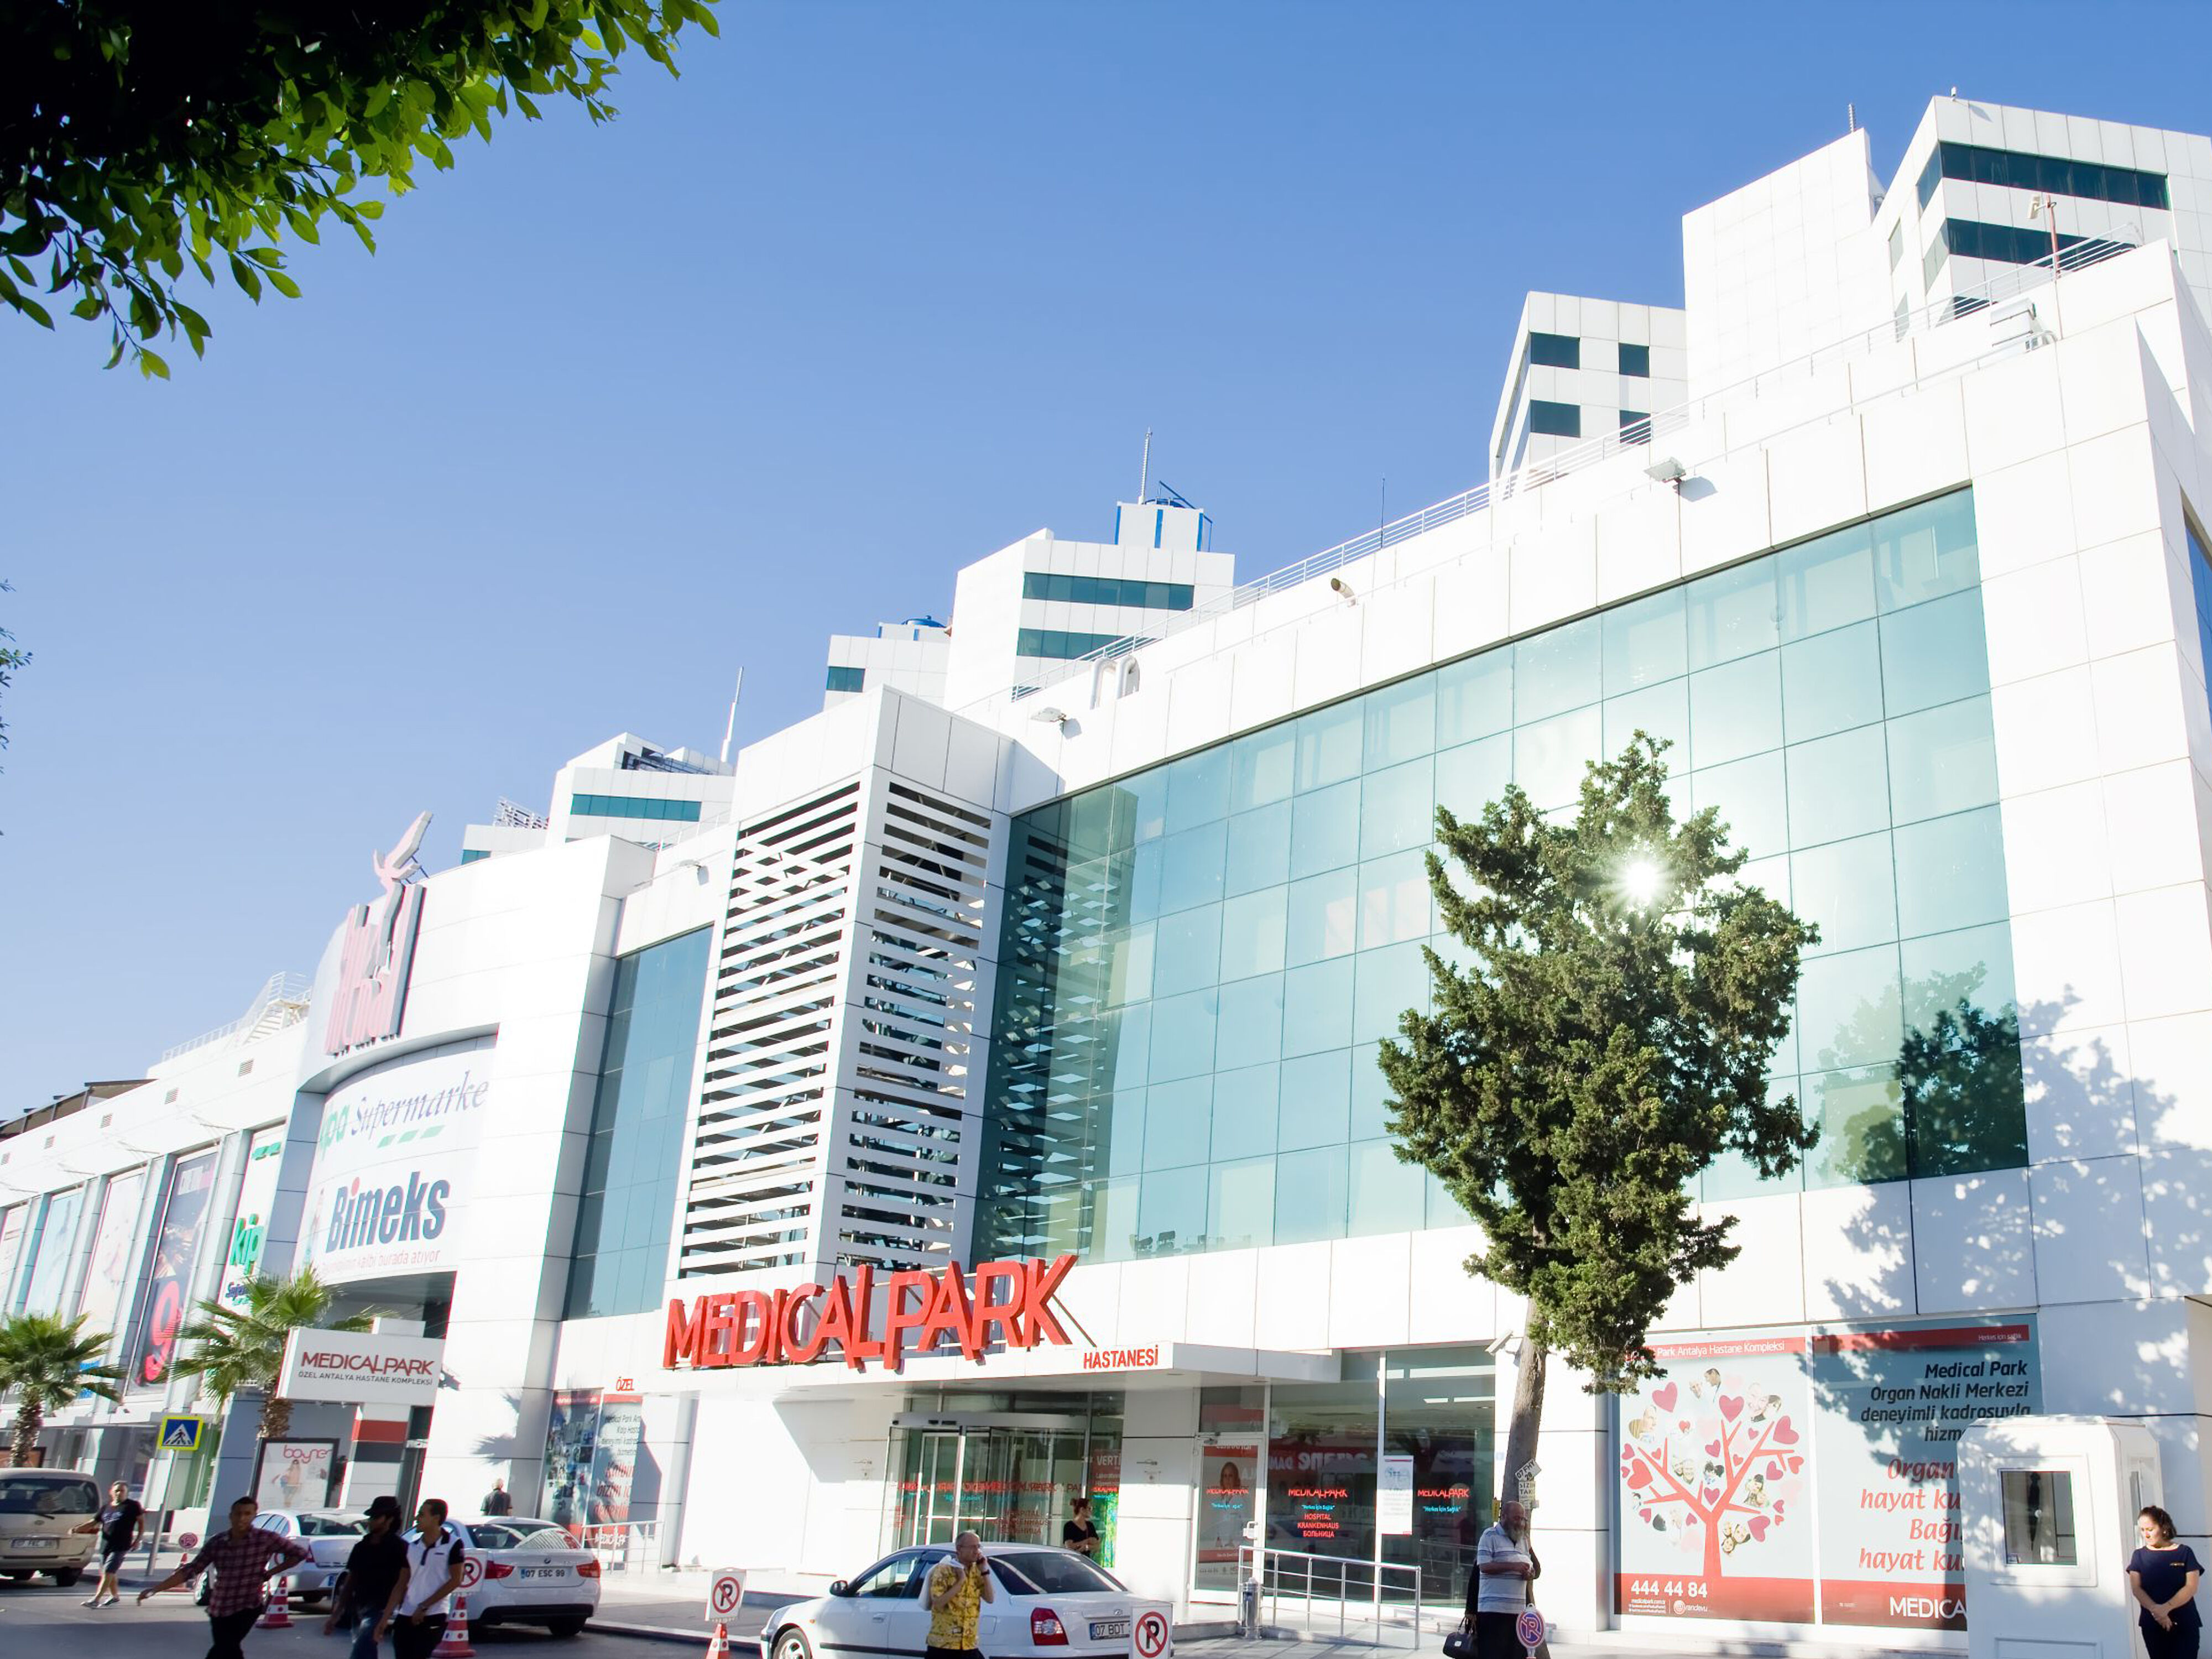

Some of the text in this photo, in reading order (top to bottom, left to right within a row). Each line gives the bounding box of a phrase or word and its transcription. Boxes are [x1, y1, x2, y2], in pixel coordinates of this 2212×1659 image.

[326, 1171, 450, 1253] Bimeks
[662, 1255, 1078, 1373] MEDICALPARK
[1084, 1345, 1158, 1369] HASTANESİ
[1658, 1347, 1674, 1357] Park
[1678, 1345, 1707, 1358] Antalya
[1709, 1344, 1741, 1354] Hastane
[1744, 1340, 1785, 1354] Kompleksi
[301, 1352, 435, 1376] MEDICALPARK
[1925, 1360, 2027, 1379] Medical Park
[319, 1373, 354, 1381] ANTALYA
[616, 1376, 634, 1391] ÖZEL
[1871, 1381, 2029, 1404] Organ Nakli Merkezi
[1861, 1406, 1935, 1425] deneyimli
[1888, 1458, 1954, 1483] Organ
[1417, 1489, 1469, 1498] MEDICALPARK
[1860, 1489, 1926, 1512] hayat
[1910, 1518, 1963, 1545] Bağı
[1859, 1548, 1965, 1573] hayat ku
[1631, 1580, 1708, 1598] 444 44 84
[1095, 1624, 1125, 1636] 07 BDT
